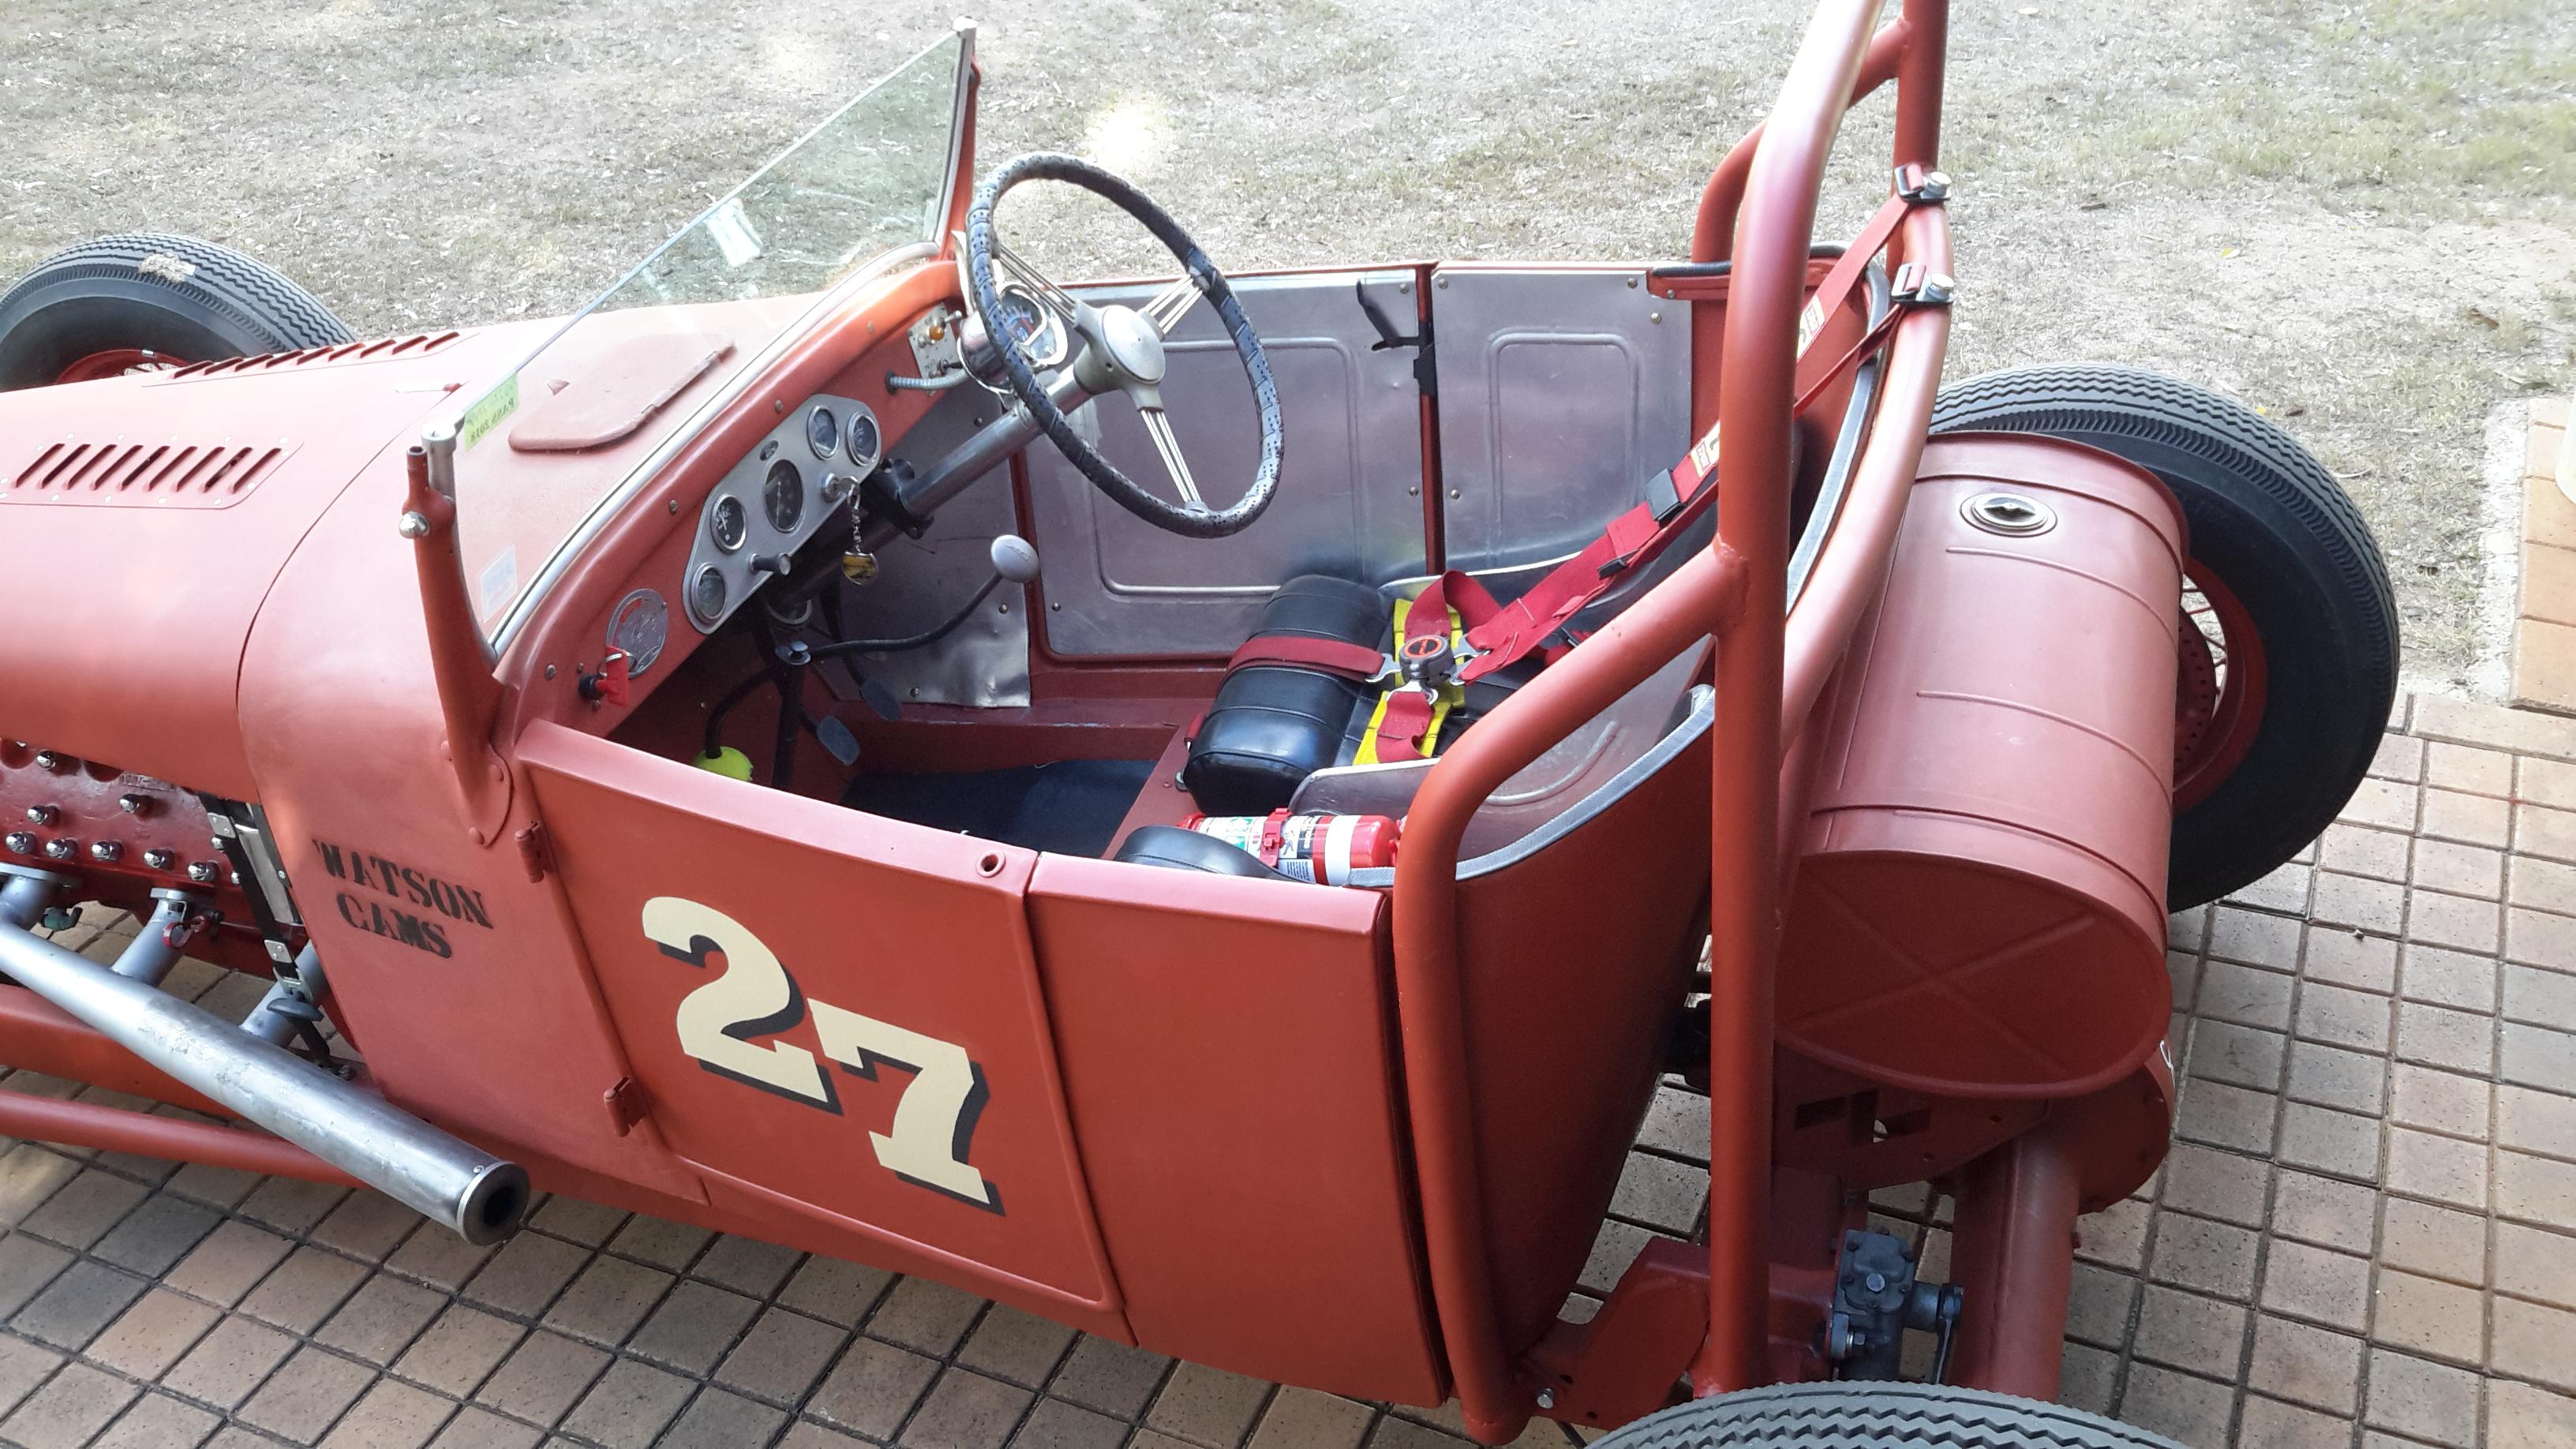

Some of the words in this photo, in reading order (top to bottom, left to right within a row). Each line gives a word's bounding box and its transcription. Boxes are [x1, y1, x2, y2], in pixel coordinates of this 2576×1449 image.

[313, 839, 493, 930] WATSON
[336, 893, 452, 960] CAMS
[642, 897, 1005, 1216] 27
